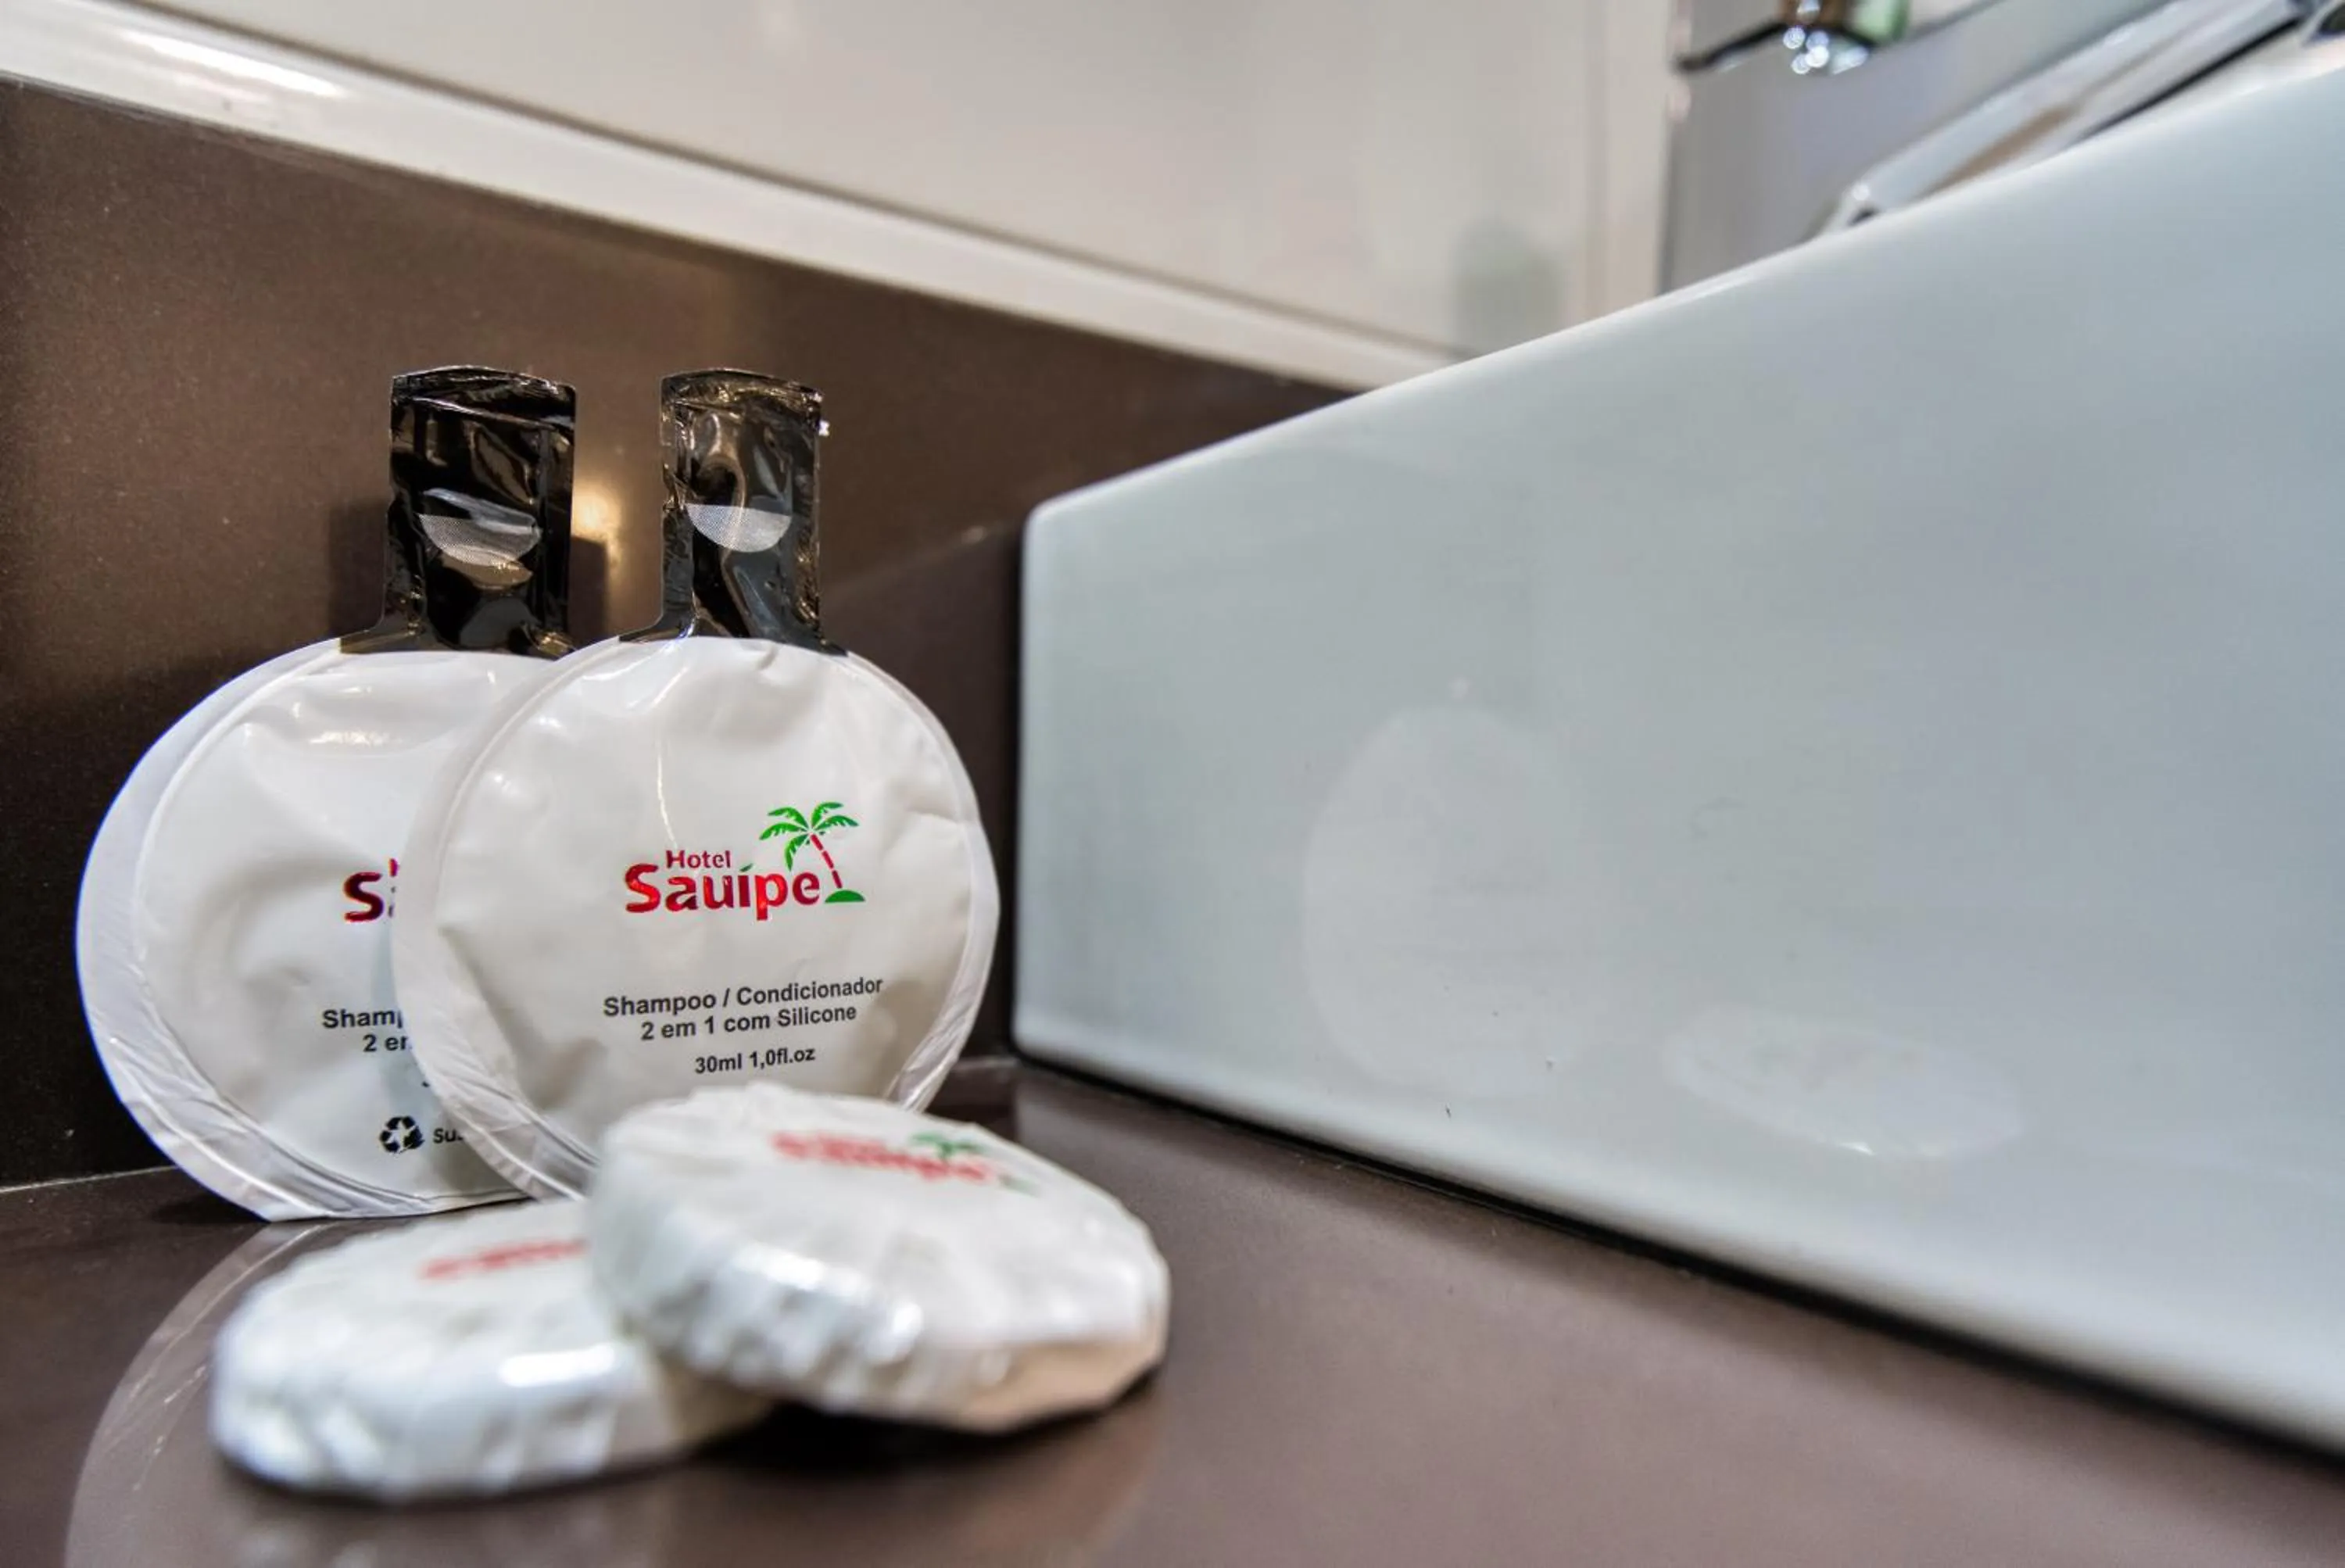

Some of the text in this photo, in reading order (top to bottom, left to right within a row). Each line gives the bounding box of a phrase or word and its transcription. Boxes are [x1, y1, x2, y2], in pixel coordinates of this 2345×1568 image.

[666, 850, 731, 869] Hotel
[343, 871, 396, 922] S
[603, 977, 884, 1017] Shampoo / Condicionador
[641, 1004, 857, 1040] 2 em 1 com Silicone
[363, 1034, 378, 1052] 2
[695, 1047, 815, 1074] 30ml 1,0fl.oz
